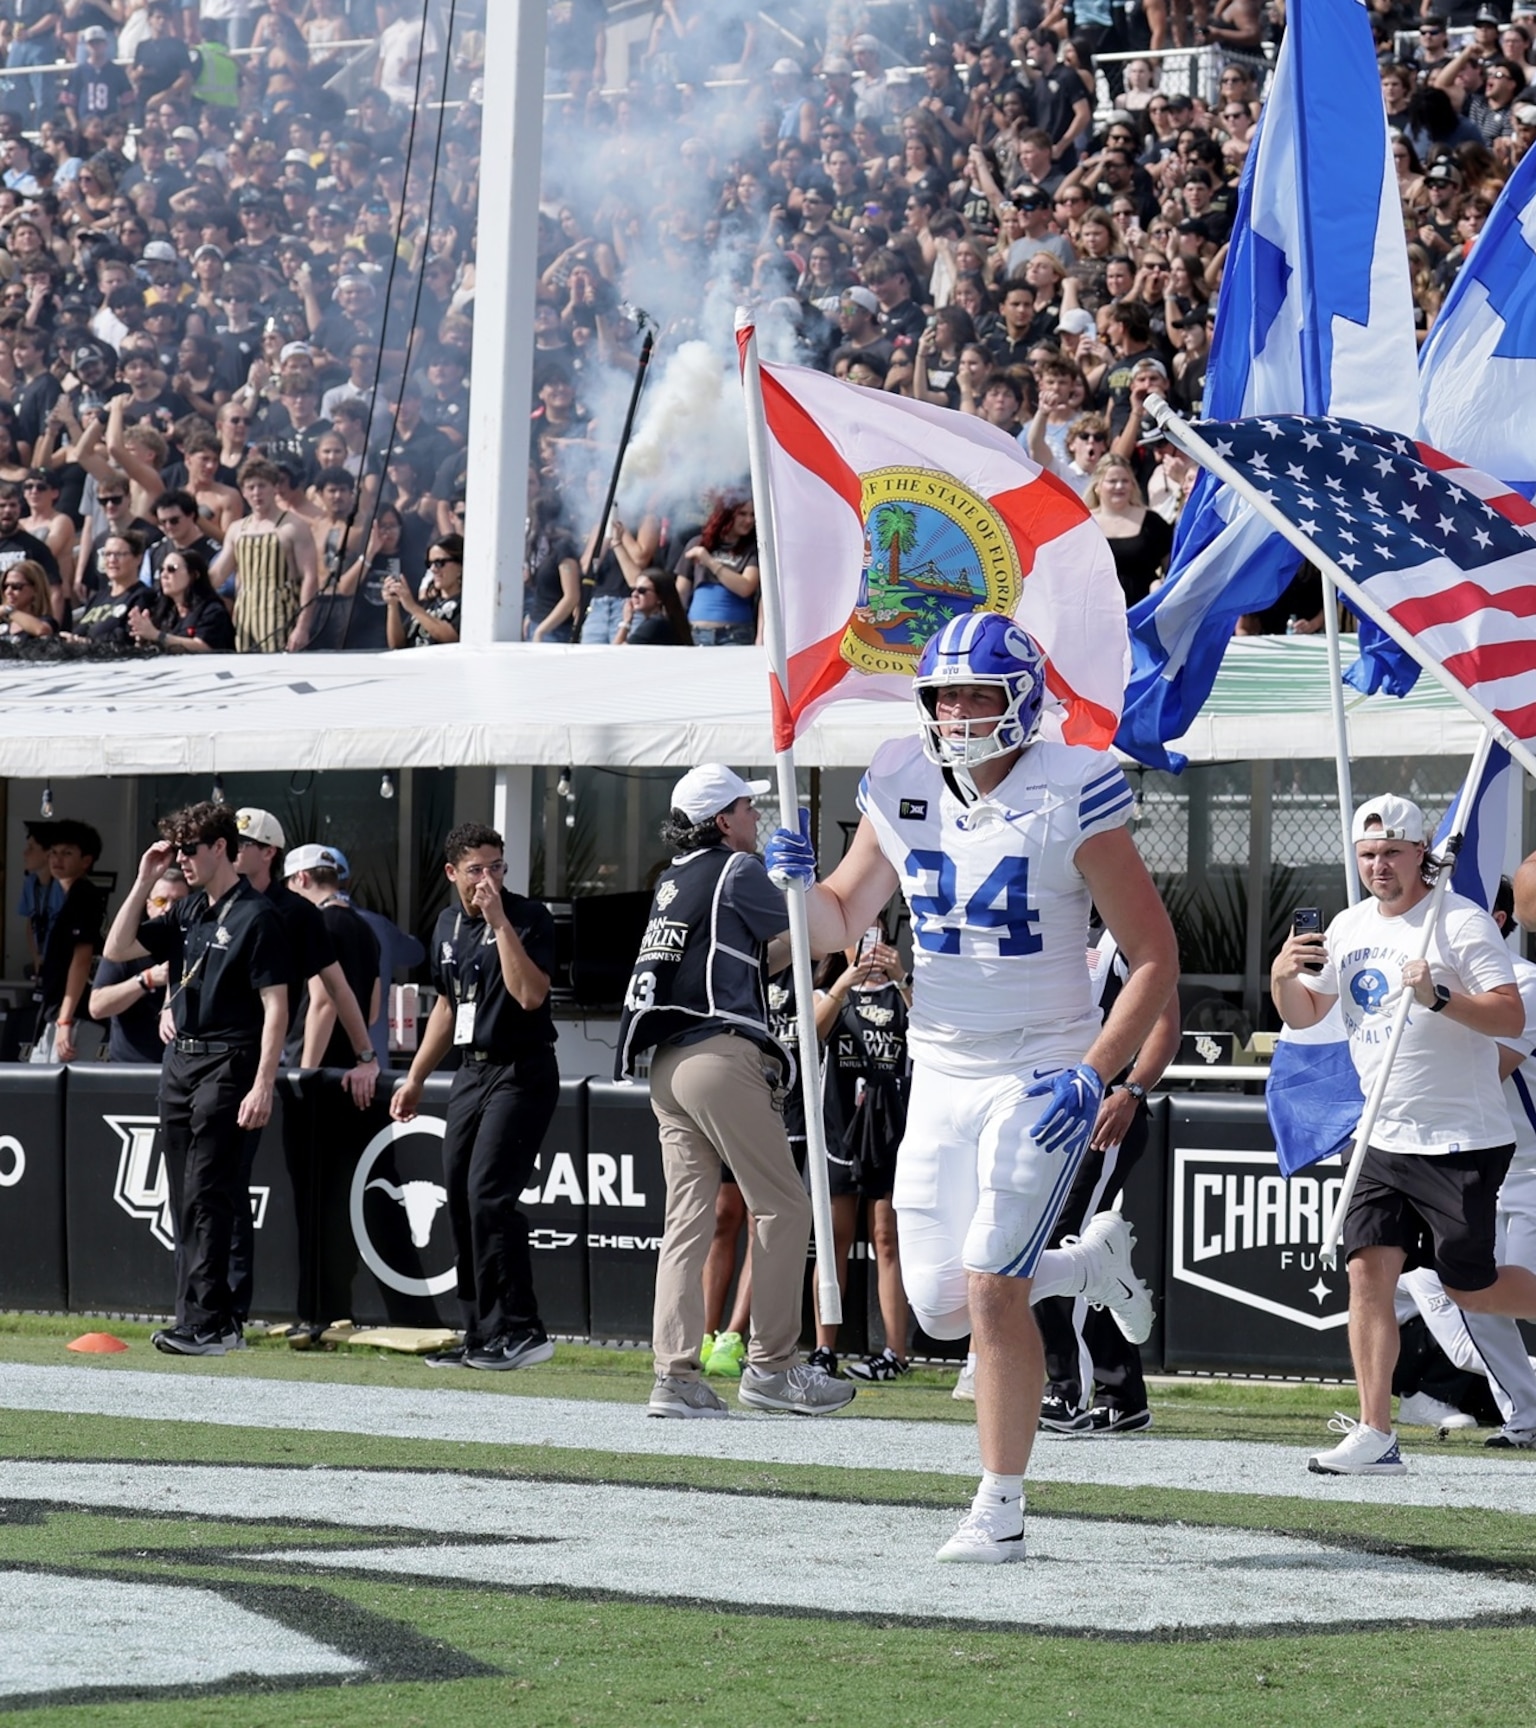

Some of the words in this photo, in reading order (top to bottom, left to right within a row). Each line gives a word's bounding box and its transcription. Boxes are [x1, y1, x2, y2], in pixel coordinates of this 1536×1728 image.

[883, 478, 921, 493] THE
[925, 483, 979, 520] STATE
[975, 518, 996, 542] OF
[989, 544, 1010, 614] FLORID
[861, 653, 904, 672] GOD
[904, 848, 1044, 957] 24
[1339, 947, 1397, 973] ATURDAY
[863, 1030, 895, 1043] DAN
[587, 1236, 664, 1251] CHEVR
[1281, 1252, 1349, 1272] FUN
